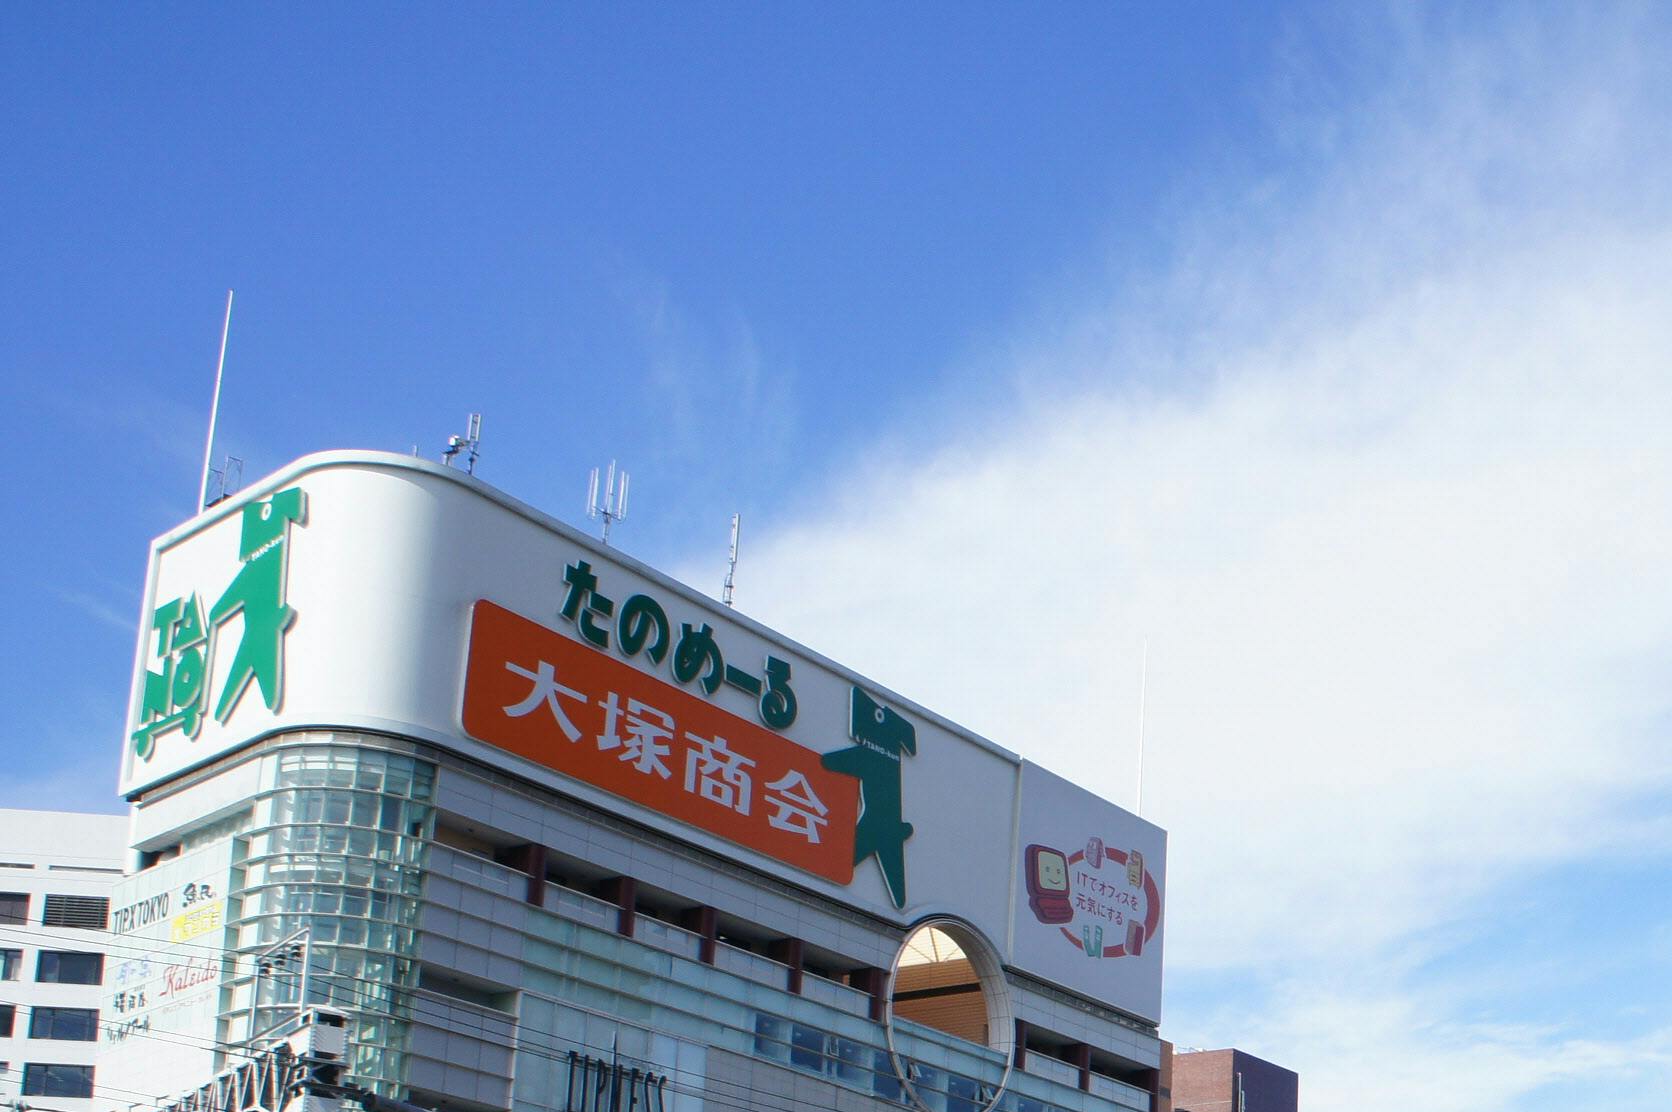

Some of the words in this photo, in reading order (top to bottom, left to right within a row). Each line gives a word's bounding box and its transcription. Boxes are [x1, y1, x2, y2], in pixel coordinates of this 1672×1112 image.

[152, 591, 208, 658] TA
[561, 558, 798, 730] たのめーる
[141, 645, 204, 724] NO
[503, 658, 829, 844] 大塚商会
[138, 891, 169, 928] TOKYO
[1076, 871, 1139, 912] ITでオフィスを
[1076, 892, 1123, 926] 元気にする
[159, 953, 217, 999] Kaleido
